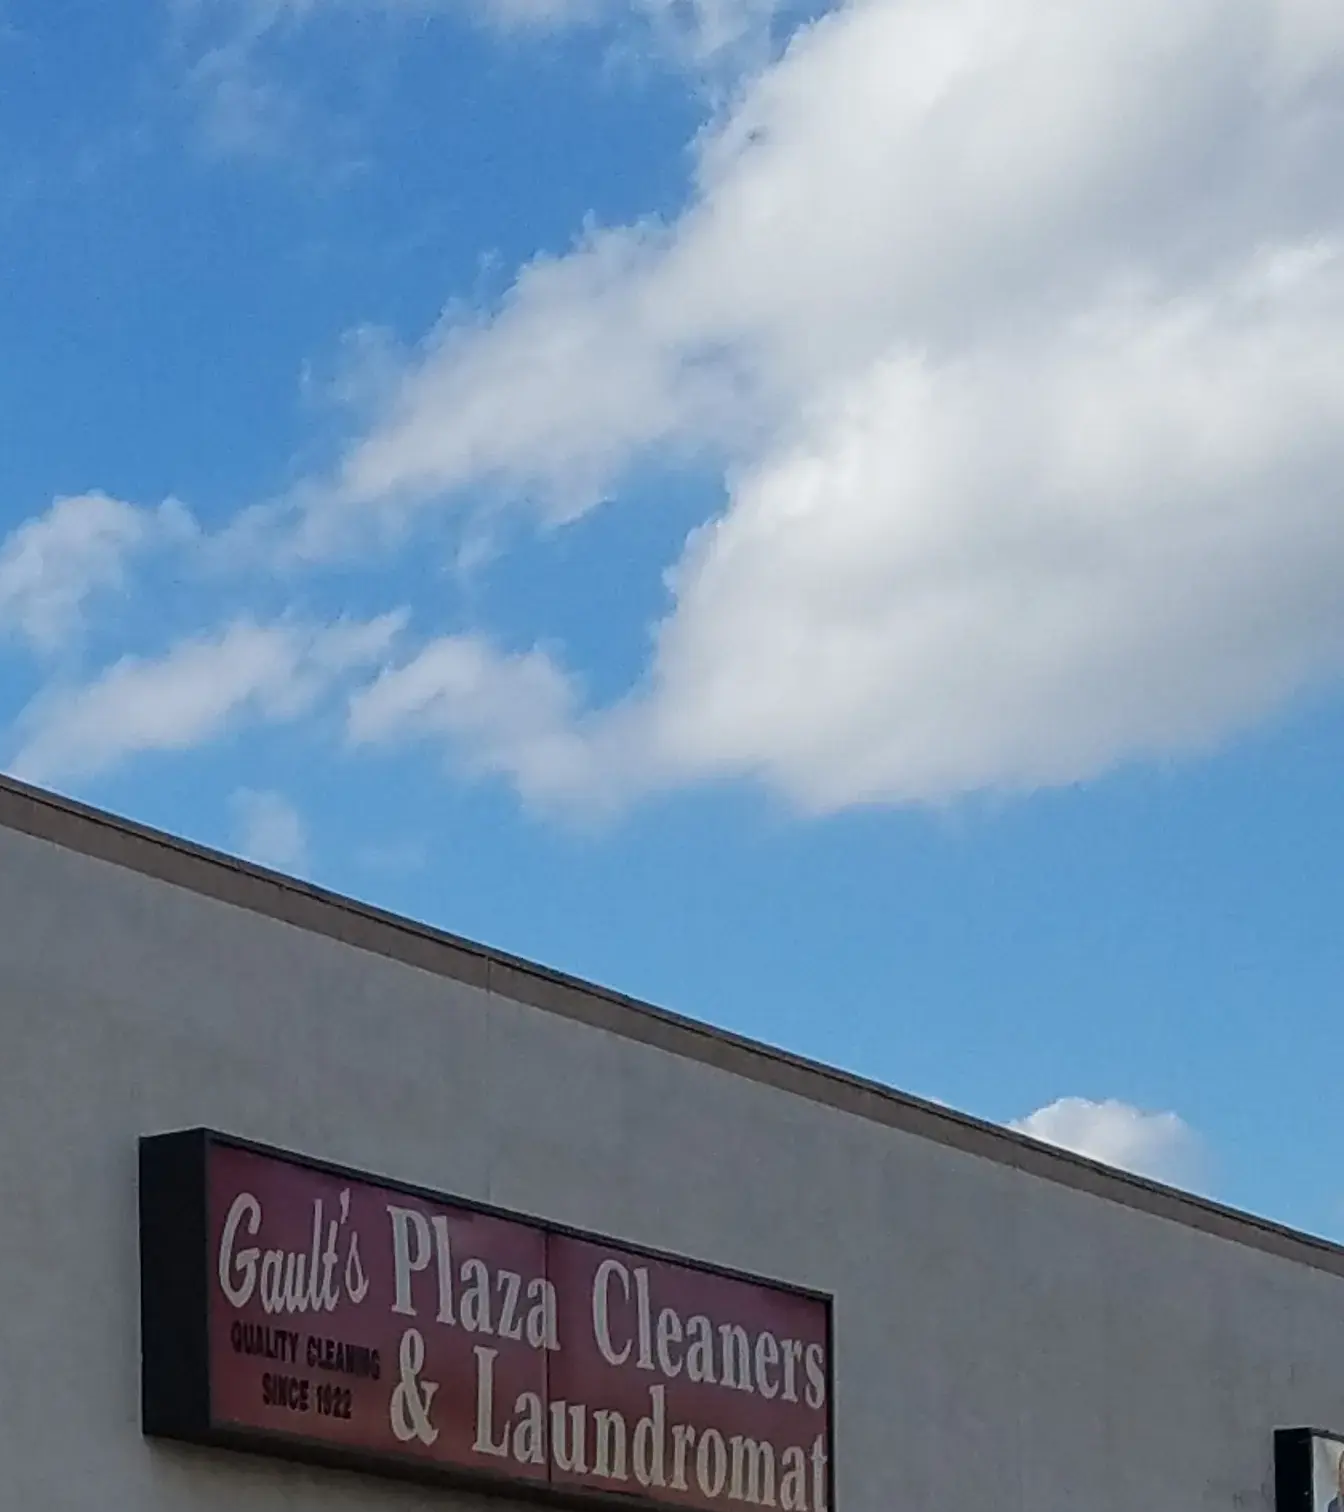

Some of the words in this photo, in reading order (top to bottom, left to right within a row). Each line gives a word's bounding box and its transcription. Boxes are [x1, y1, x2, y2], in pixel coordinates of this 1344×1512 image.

[218, 1188, 370, 1315] Gault's
[386, 1204, 561, 1352] Plaza
[592, 1258, 826, 1410] Cleaners
[230, 1320, 300, 1364] QUALITY
[306, 1335, 381, 1381] CLEANING
[262, 1372, 310, 1412] SINCE
[390, 1328, 440, 1446] &
